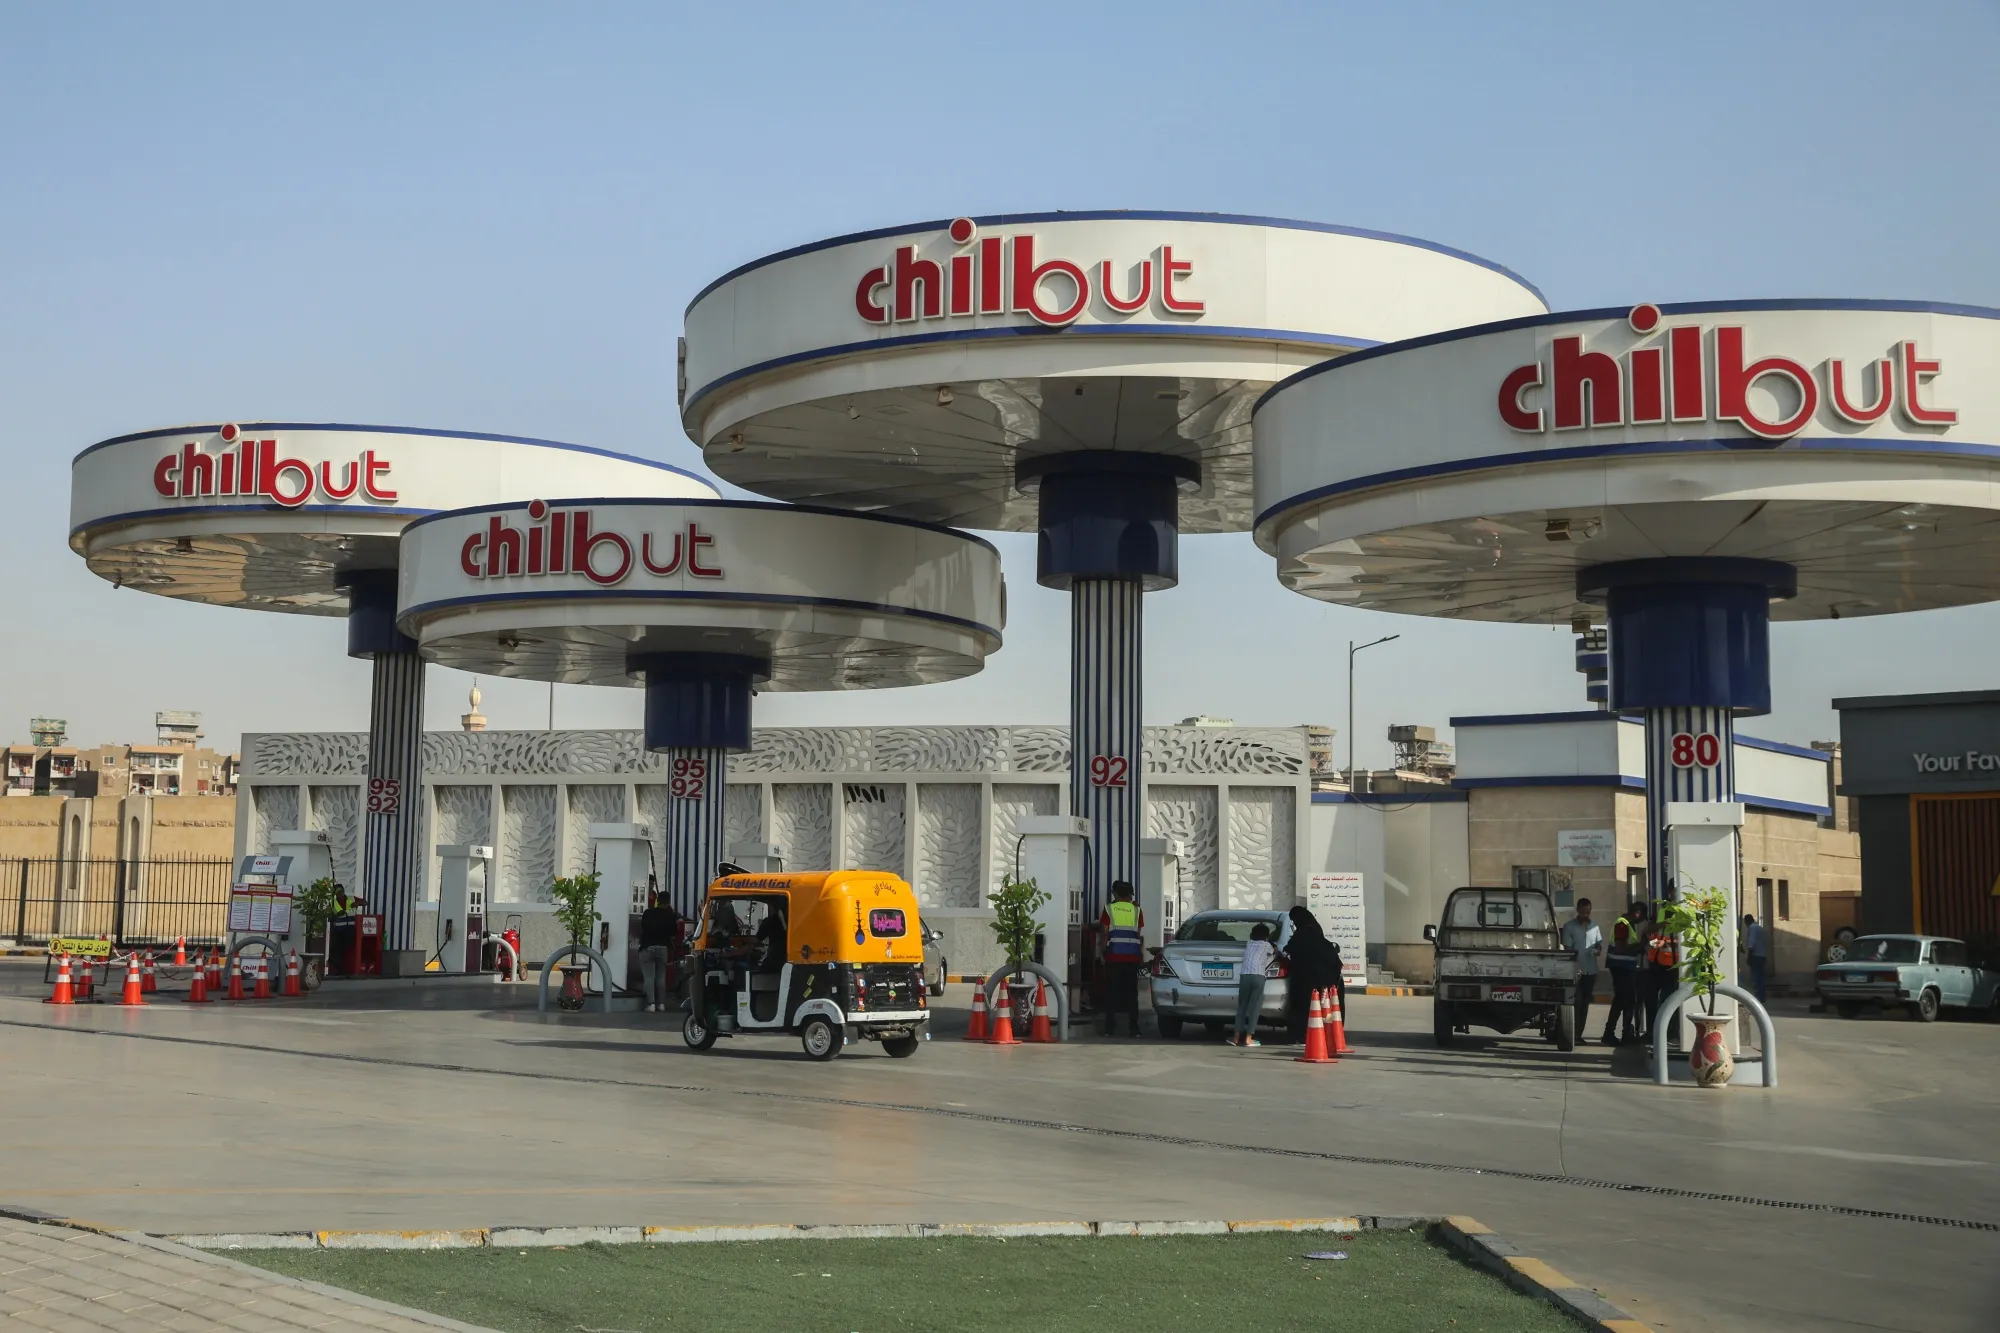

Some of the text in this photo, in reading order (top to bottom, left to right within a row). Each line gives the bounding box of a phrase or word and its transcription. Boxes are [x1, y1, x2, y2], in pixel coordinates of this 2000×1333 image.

[1671, 732, 1721, 768] 80
[673, 757, 706, 779] 95
[1090, 755, 1128, 787] 92
[1912, 753, 1961, 773] Your
[369, 777, 400, 797] 95
[671, 777, 704, 799] 92
[367, 795, 398, 814] 92
